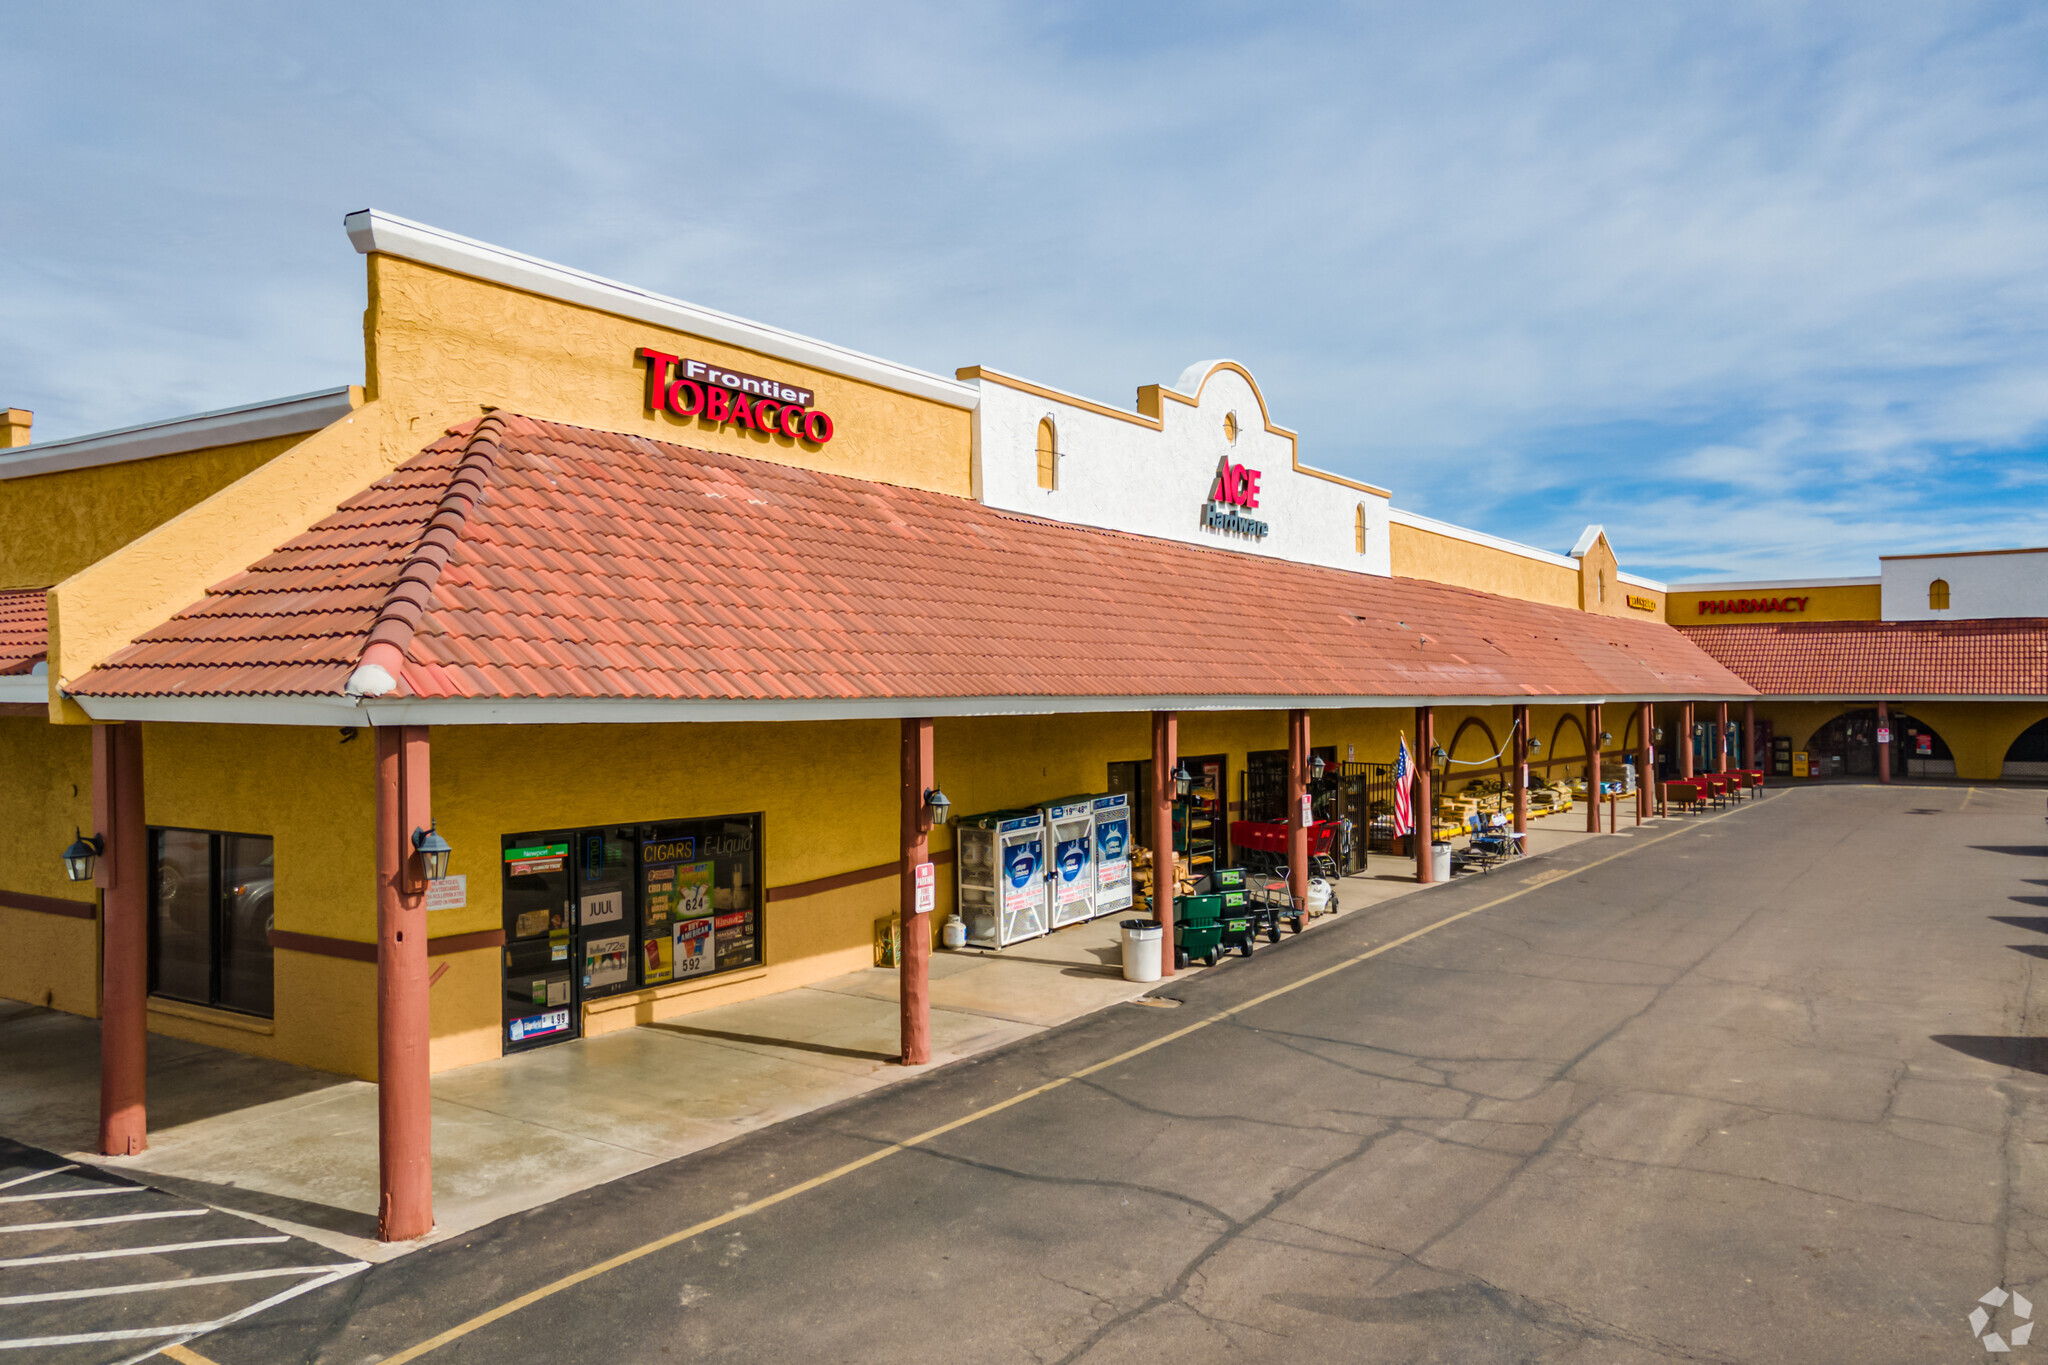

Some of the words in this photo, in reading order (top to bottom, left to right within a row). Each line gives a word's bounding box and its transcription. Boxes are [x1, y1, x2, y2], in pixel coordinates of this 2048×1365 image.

[686, 358, 810, 405] Frontier
[642, 347, 834, 444] TOBACCO
[1212, 455, 1262, 508] ACE
[1205, 503, 1269, 538] Hardware
[1698, 596, 1809, 616] PHARMACY
[644, 842, 692, 863] CIGARS
[703, 832, 753, 858] E-Liquid
[523, 849, 548, 858] Newport
[680, 865, 694, 875] OUR
[921, 867, 928, 876] NO
[648, 883, 661, 894] CBD
[662, 882, 673, 892] OIL
[916, 876, 934, 886] PARKING
[589, 900, 614, 917] JUUL
[685, 897, 703, 911] 624
[680, 924, 709, 941] AMERICAN
[687, 921, 699, 931] BUY
[605, 941, 625, 952] 72s
[682, 957, 700, 972] 592
